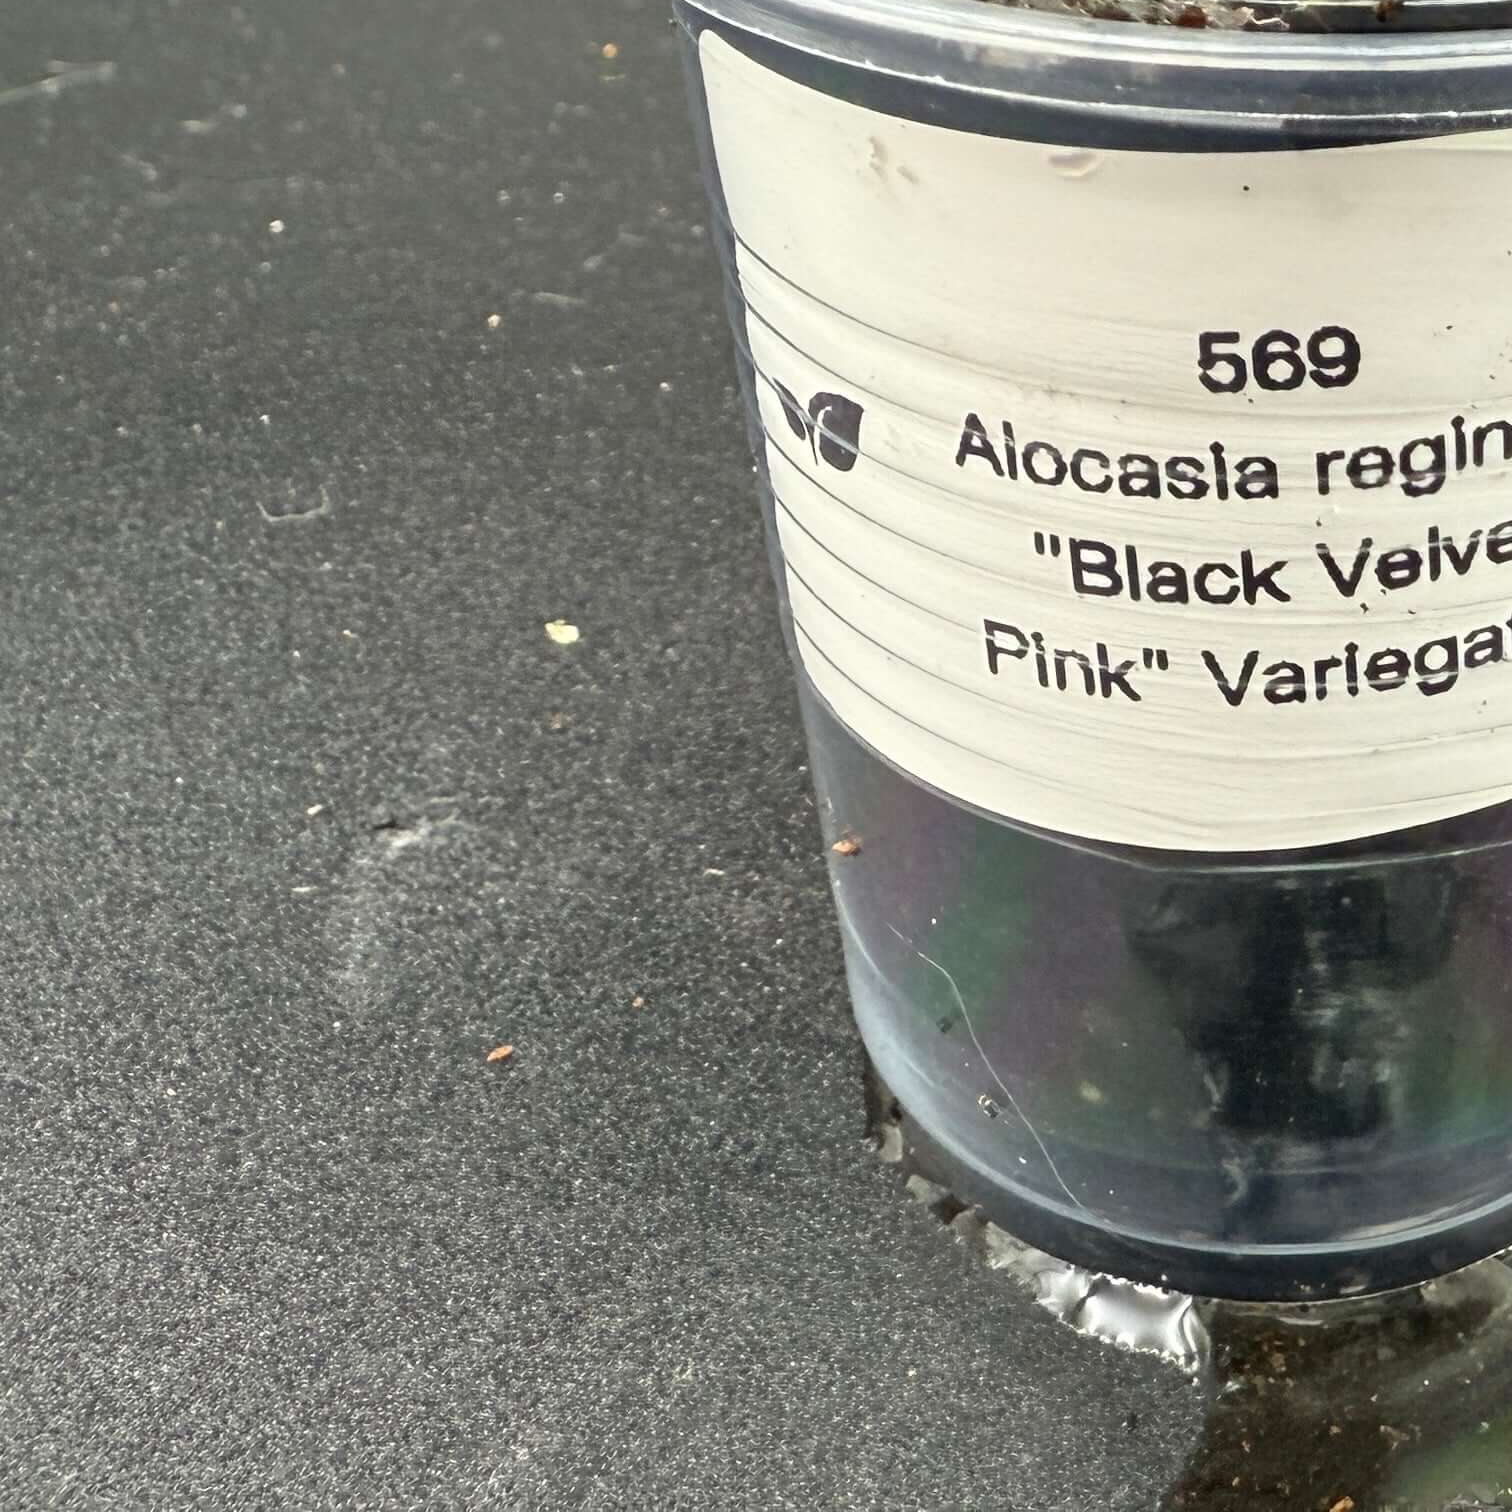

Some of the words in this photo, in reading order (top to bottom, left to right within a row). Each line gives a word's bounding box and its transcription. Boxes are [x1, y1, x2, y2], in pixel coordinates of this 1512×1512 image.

[1197, 325, 1361, 394] 569
[955, 412, 1280, 501] Alocasia
[1034, 532, 1291, 607] "Black
[983, 619, 1170, 702] Pink"
